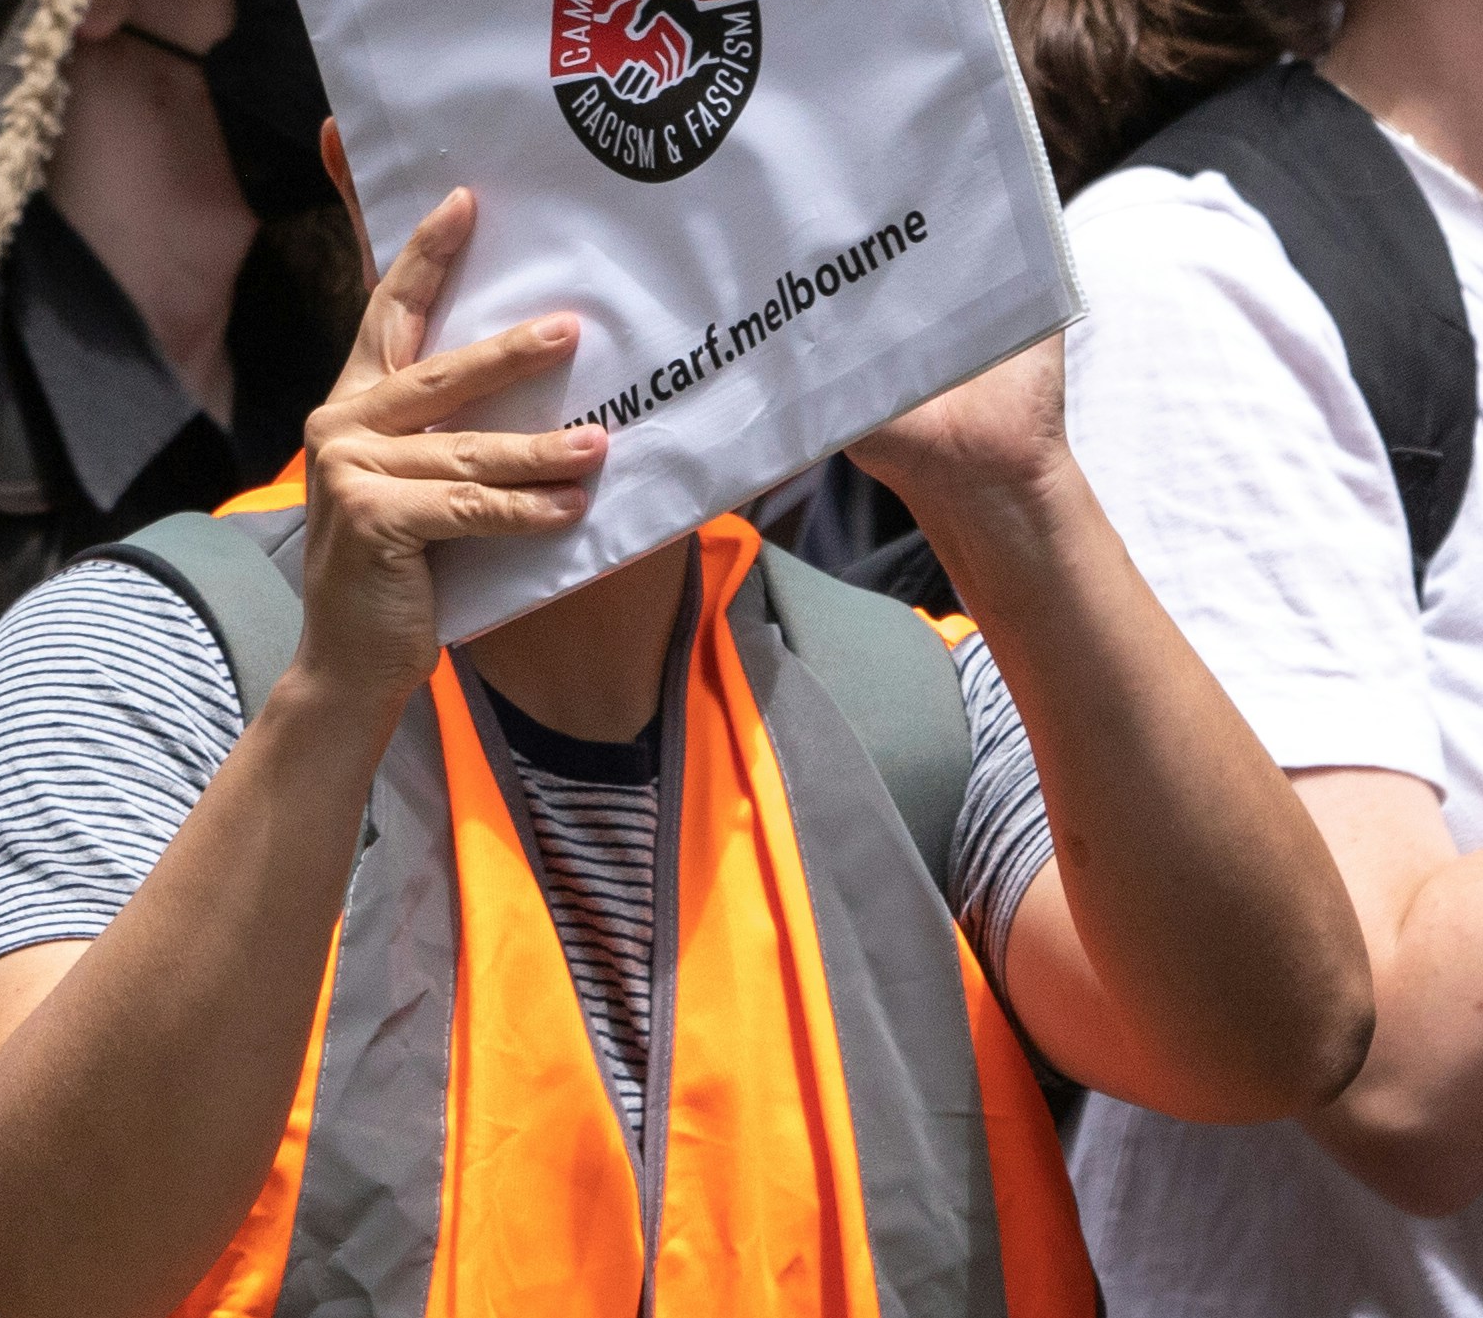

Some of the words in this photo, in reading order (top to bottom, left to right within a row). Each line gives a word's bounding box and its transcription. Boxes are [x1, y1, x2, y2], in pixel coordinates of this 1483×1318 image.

[571, 83, 656, 170] RACISM
[663, 124, 684, 164] &
[685, 10, 754, 149] FASCISM
[563, 210, 927, 434] w.carf.melbourne
